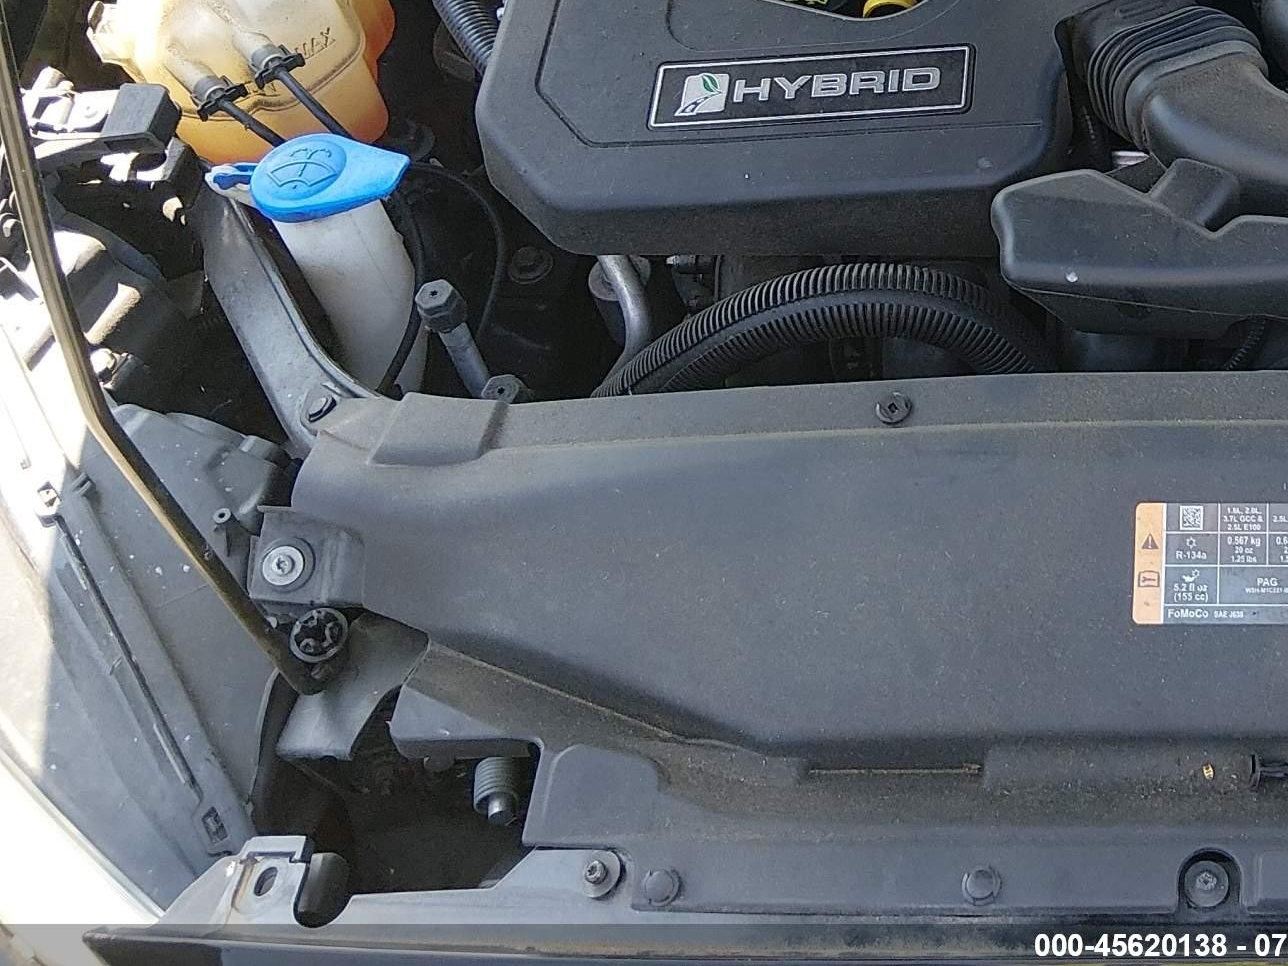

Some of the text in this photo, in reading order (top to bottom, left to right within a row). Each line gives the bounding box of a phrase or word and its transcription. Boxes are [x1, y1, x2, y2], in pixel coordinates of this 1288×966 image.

[733, 67, 941, 103] HYBRID
[1227, 536, 1261, 547] 0.567 kg
[1175, 550, 1207, 560] R-134a
[1234, 546, 1244, 554] 20
[1246, 555, 1257, 563] lbs
[1256, 577, 1278, 586] PAG
[1173, 583, 1208, 592] 5.2 fl oz
[1173, 592, 1209, 602] (155 cc)
[1167, 608, 1209, 618] FoMoCo
[1213, 610, 1228, 618] SAE
